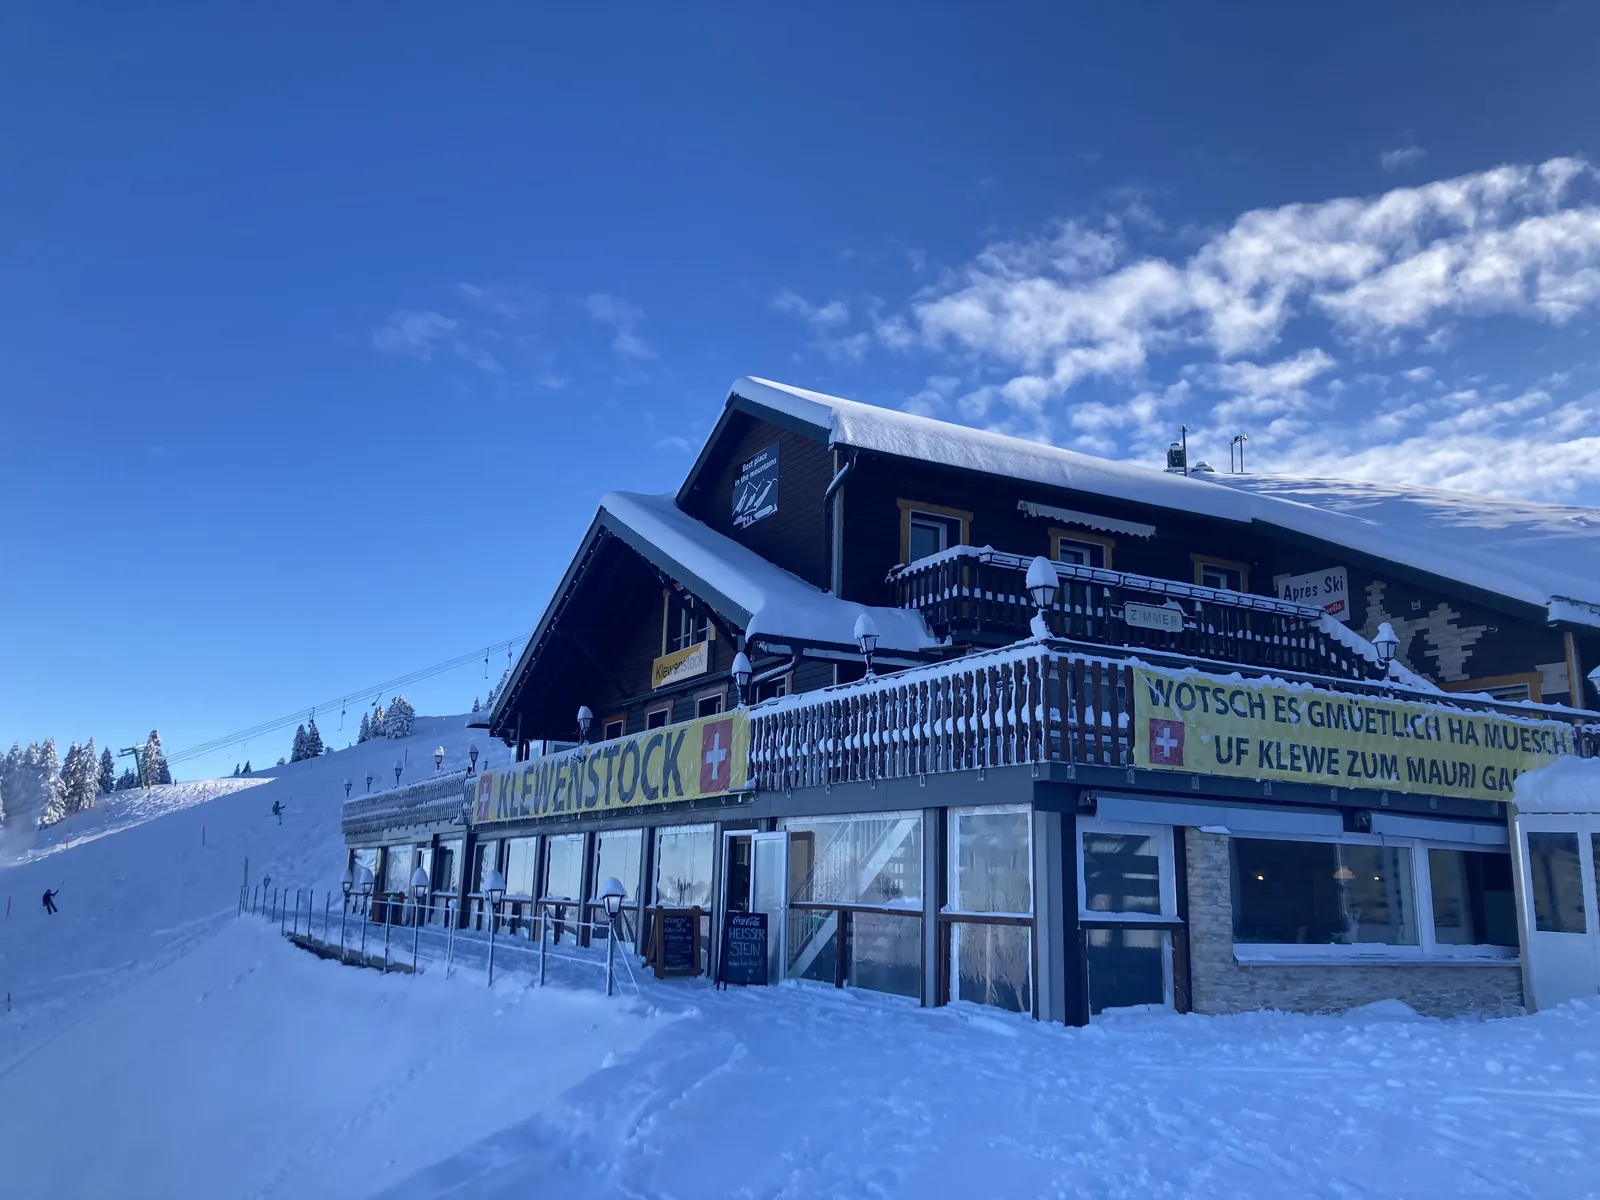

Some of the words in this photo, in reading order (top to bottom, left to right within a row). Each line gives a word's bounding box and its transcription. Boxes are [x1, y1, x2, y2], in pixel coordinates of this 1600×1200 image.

[740, 473, 749, 484] the
[750, 457, 777, 478] mountains
[742, 460, 753, 472] Best
[753, 452, 768, 468] place
[1284, 580, 1318, 602] Après
[1324, 575, 1344, 594] Ski
[1130, 609, 1178, 627] ZIMMER
[1325, 603, 1342, 614] vella
[655, 651, 704, 681] Klewenstock
[1146, 676, 1266, 721] WOTSCH
[1273, 695, 1301, 725] ES
[1307, 698, 1442, 742] GMÜETLICH
[1448, 717, 1480, 747] HA
[496, 728, 689, 819] KLEWENSTOCK
[1214, 734, 1250, 766] UF
[1258, 739, 1340, 776] KLEWE
[1347, 750, 1401, 781] ZUM
[1406, 756, 1476, 789] MAURI
[728, 927, 766, 941] HEISSER
[729, 941, 761, 957] STEIN
